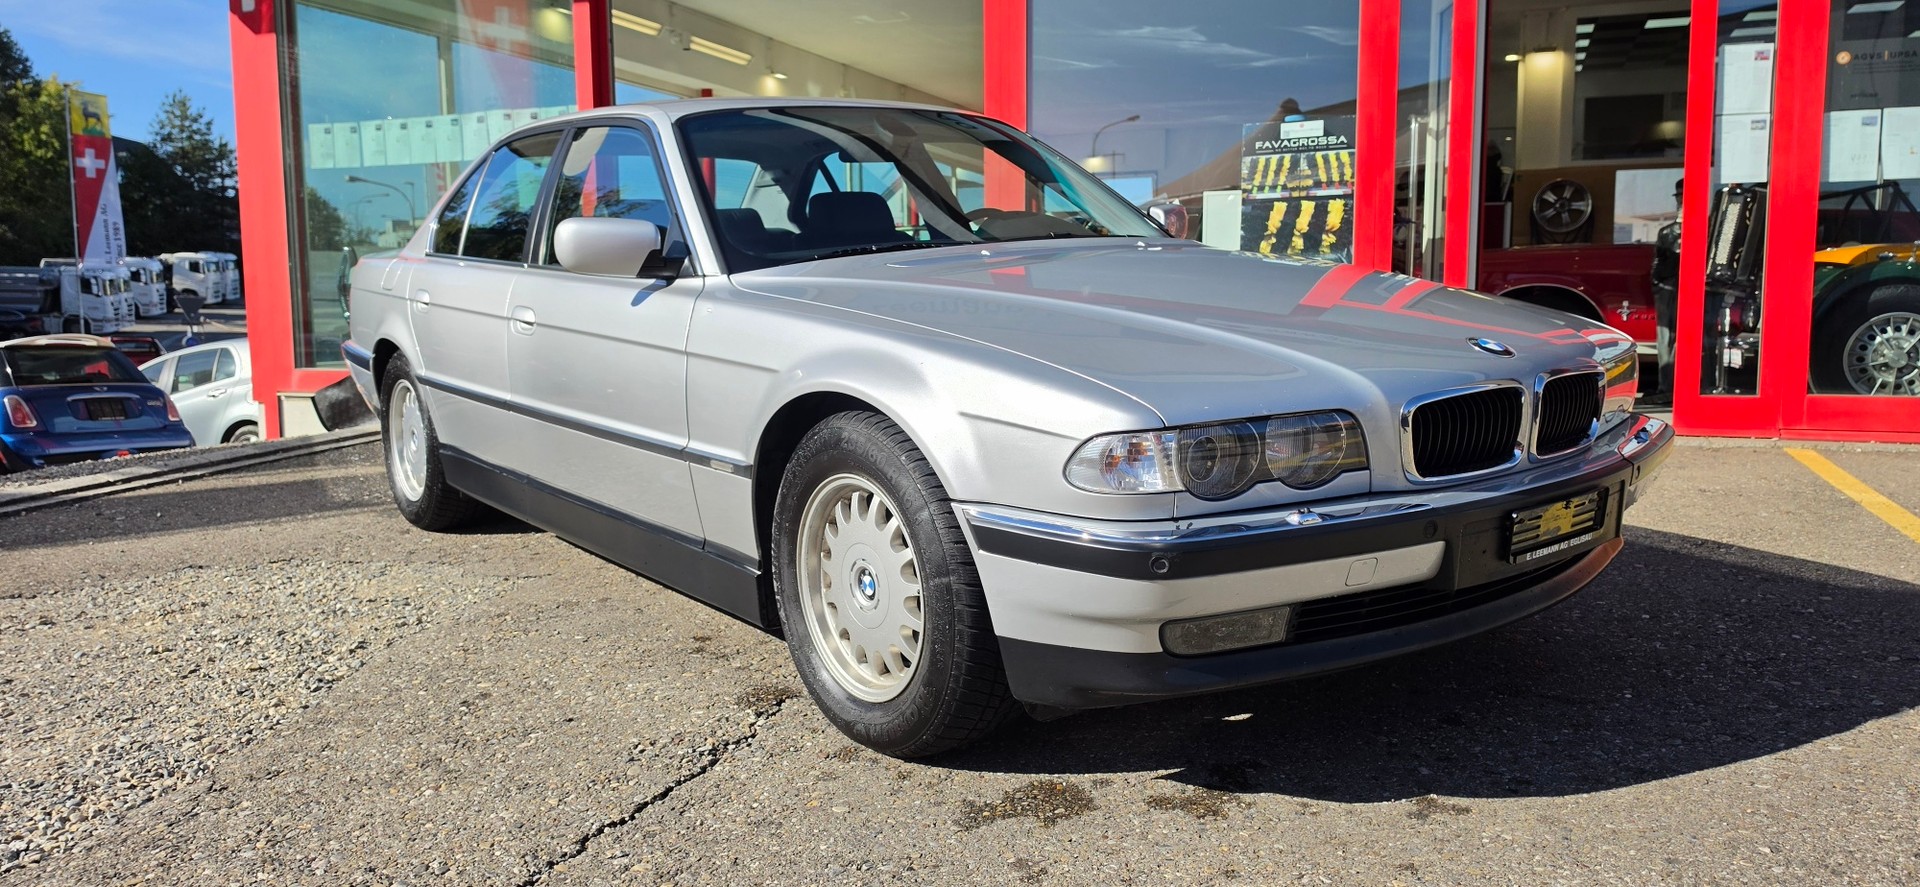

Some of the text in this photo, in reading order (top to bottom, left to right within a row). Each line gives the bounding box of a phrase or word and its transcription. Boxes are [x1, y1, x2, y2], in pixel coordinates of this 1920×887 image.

[1255, 135, 1348, 150] FAVAGROSSA
[1533, 544, 1560, 558] LEEMANN
[1560, 541, 1569, 550] AG
[1570, 533, 1593, 546] EGLISAU
